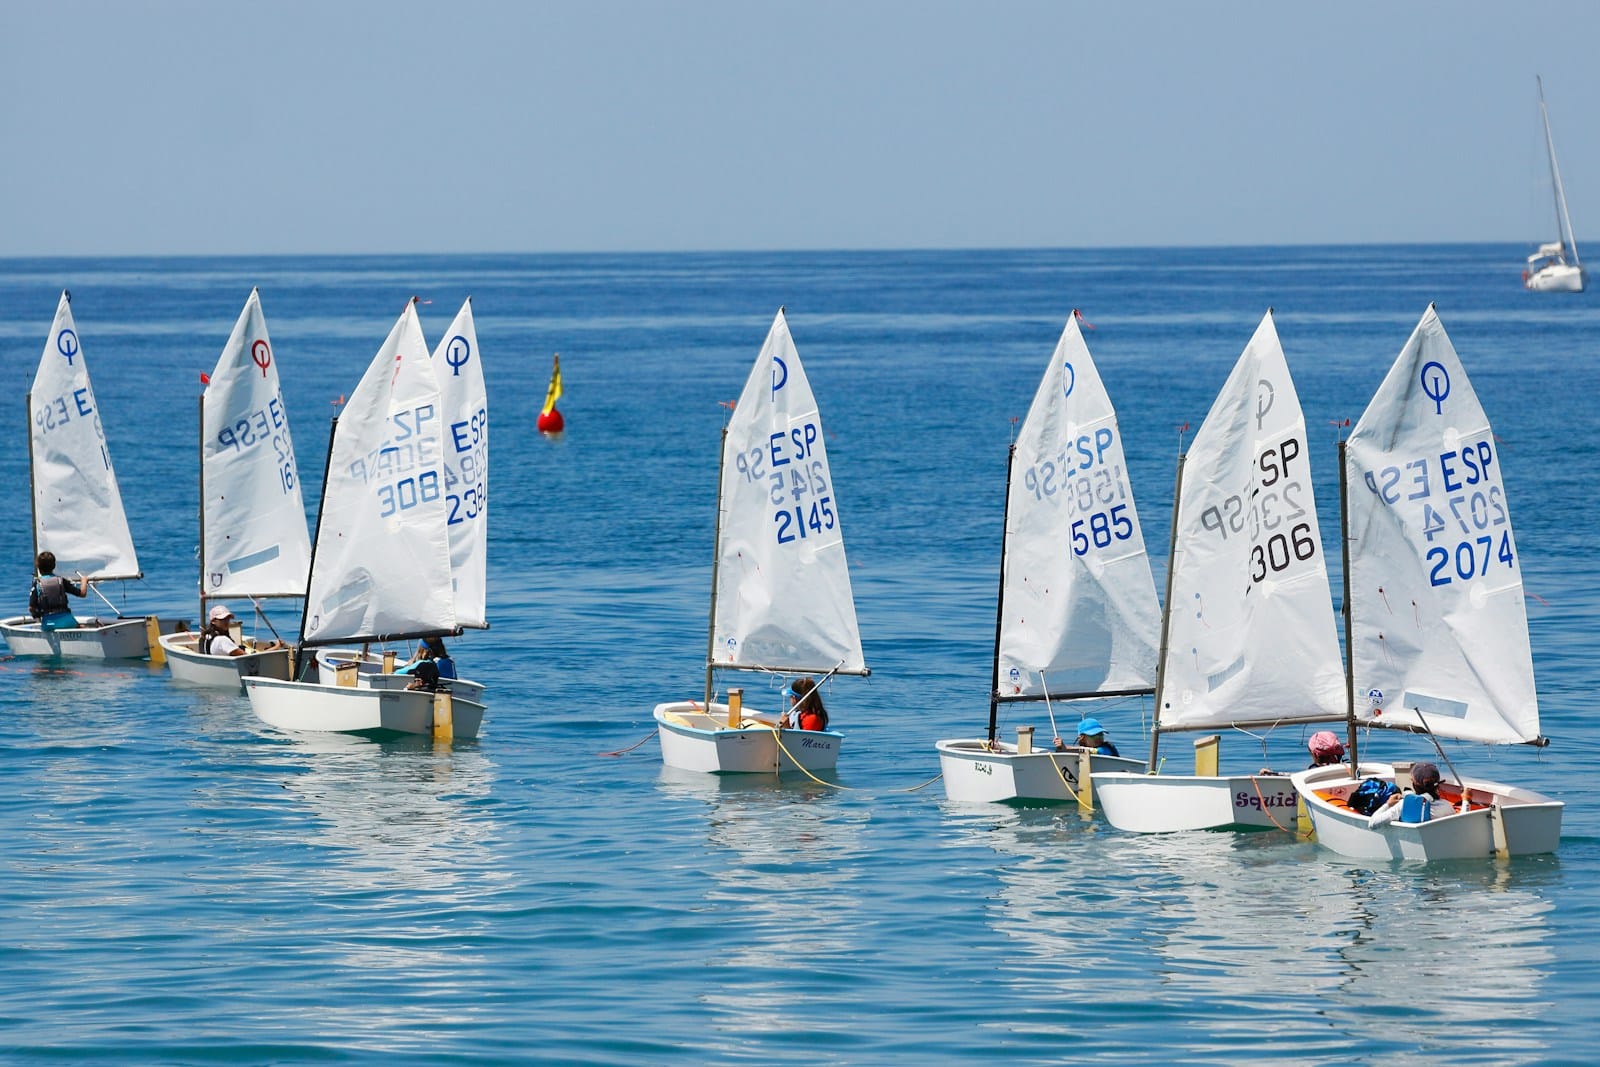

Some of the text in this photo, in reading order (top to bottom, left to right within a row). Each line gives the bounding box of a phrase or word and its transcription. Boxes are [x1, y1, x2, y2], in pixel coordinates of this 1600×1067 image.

[450, 408, 486, 453] ESP
[770, 423, 817, 467] ESP
[1252, 438, 1300, 498] SP
[1439, 441, 1492, 493] ESP
[377, 470, 440, 518] 308
[445, 482, 486, 526] 238
[774, 496, 834, 544] 2145
[1069, 503, 1133, 560] 585
[1246, 522, 1315, 597] 306
[1425, 529, 1513, 587] 2074
[1235, 791, 1297, 812] Squid
